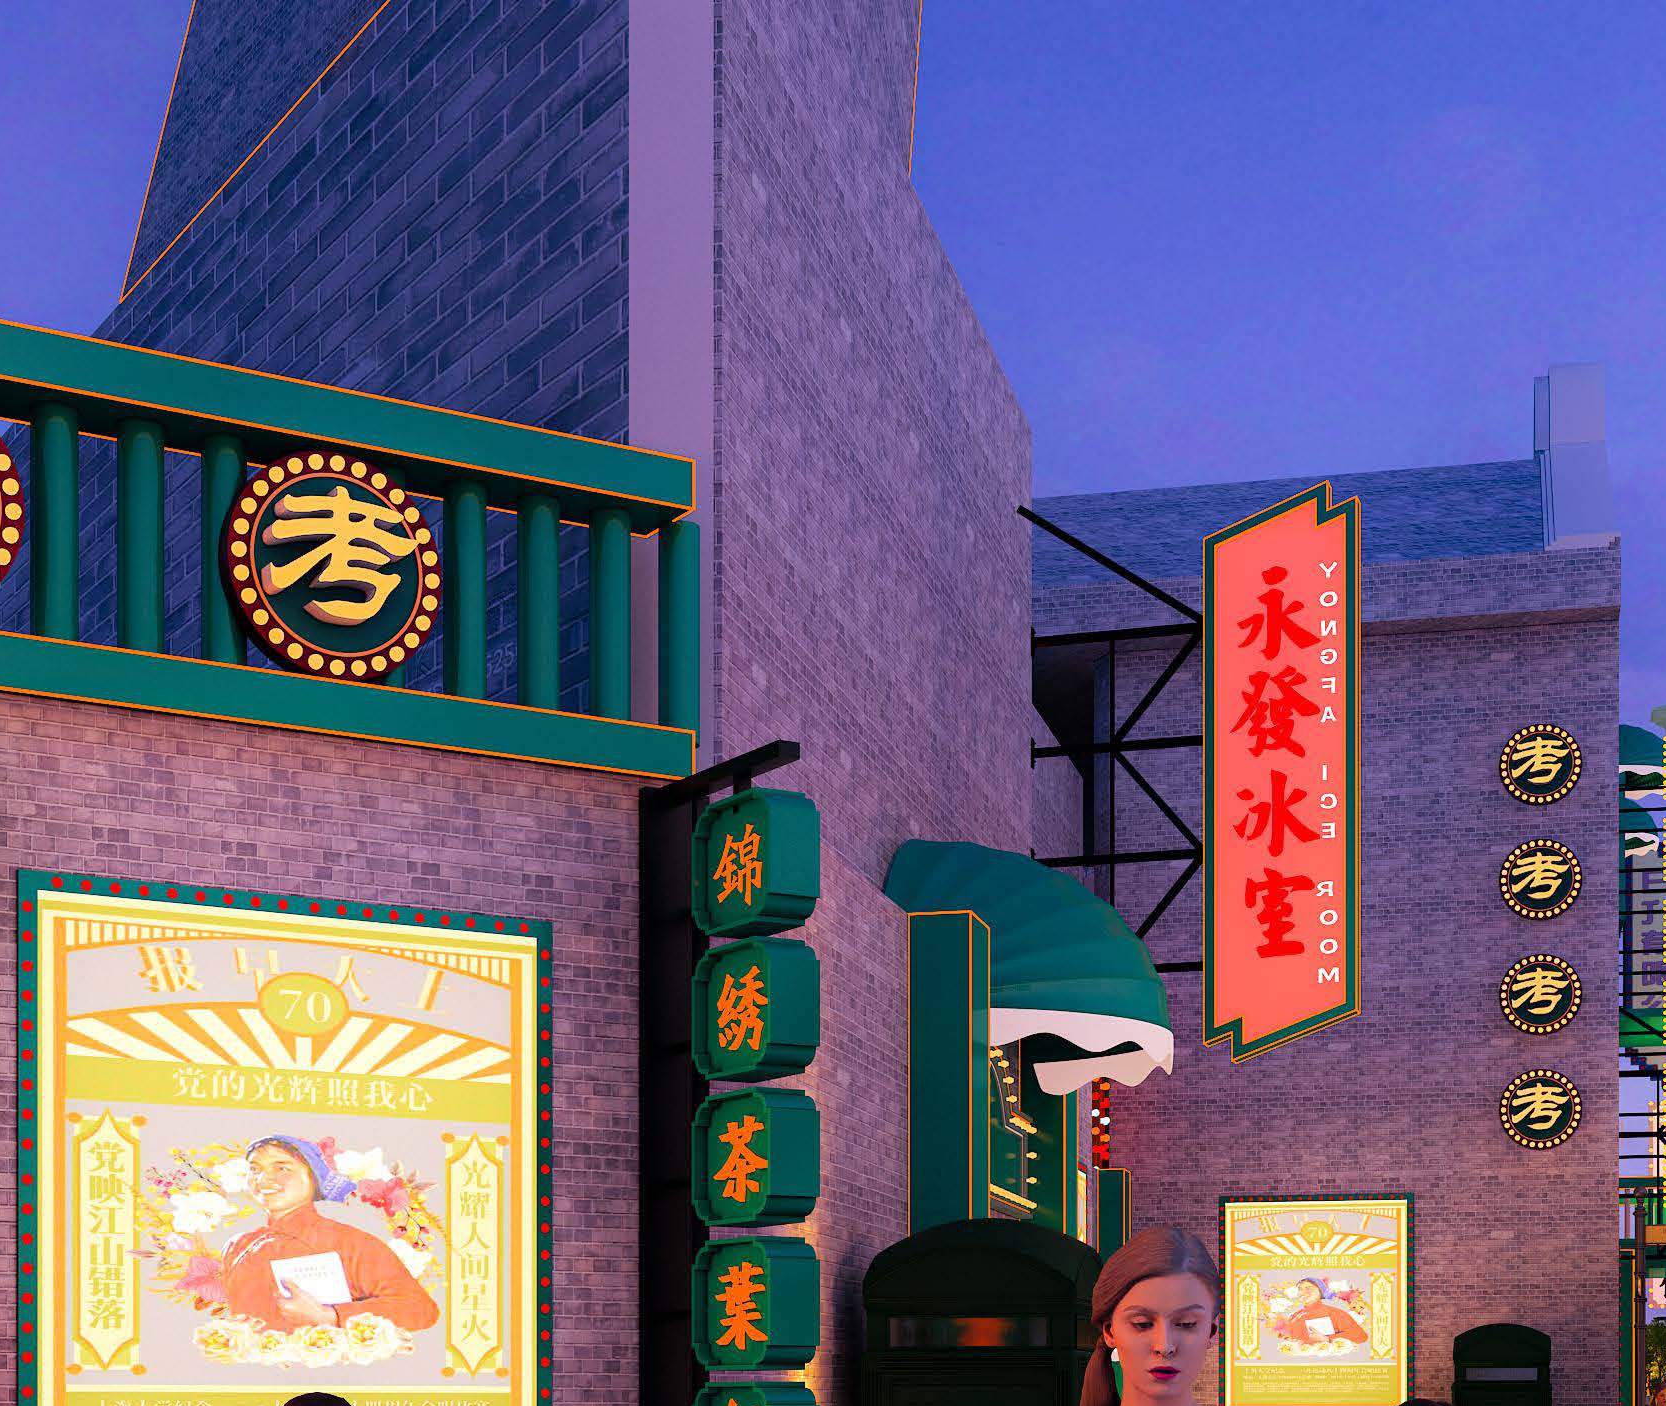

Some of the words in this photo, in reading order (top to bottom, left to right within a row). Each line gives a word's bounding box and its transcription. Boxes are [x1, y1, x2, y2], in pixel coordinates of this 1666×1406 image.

[262, 485, 420, 628] 考
[1229, 565, 1322, 959] 永發冰室
[1511, 737, 1570, 784] 考
[1511, 852, 1570, 899] 考
[278, 989, 332, 1024] 70
[1511, 968, 1570, 1015] 考
[172, 1066, 435, 1113] 党的光辉照我心
[1511, 1083, 1570, 1130] 考
[88, 1140, 126, 1330] 党映江山错落
[460, 1159, 492, 1343] 光耀人间星火
